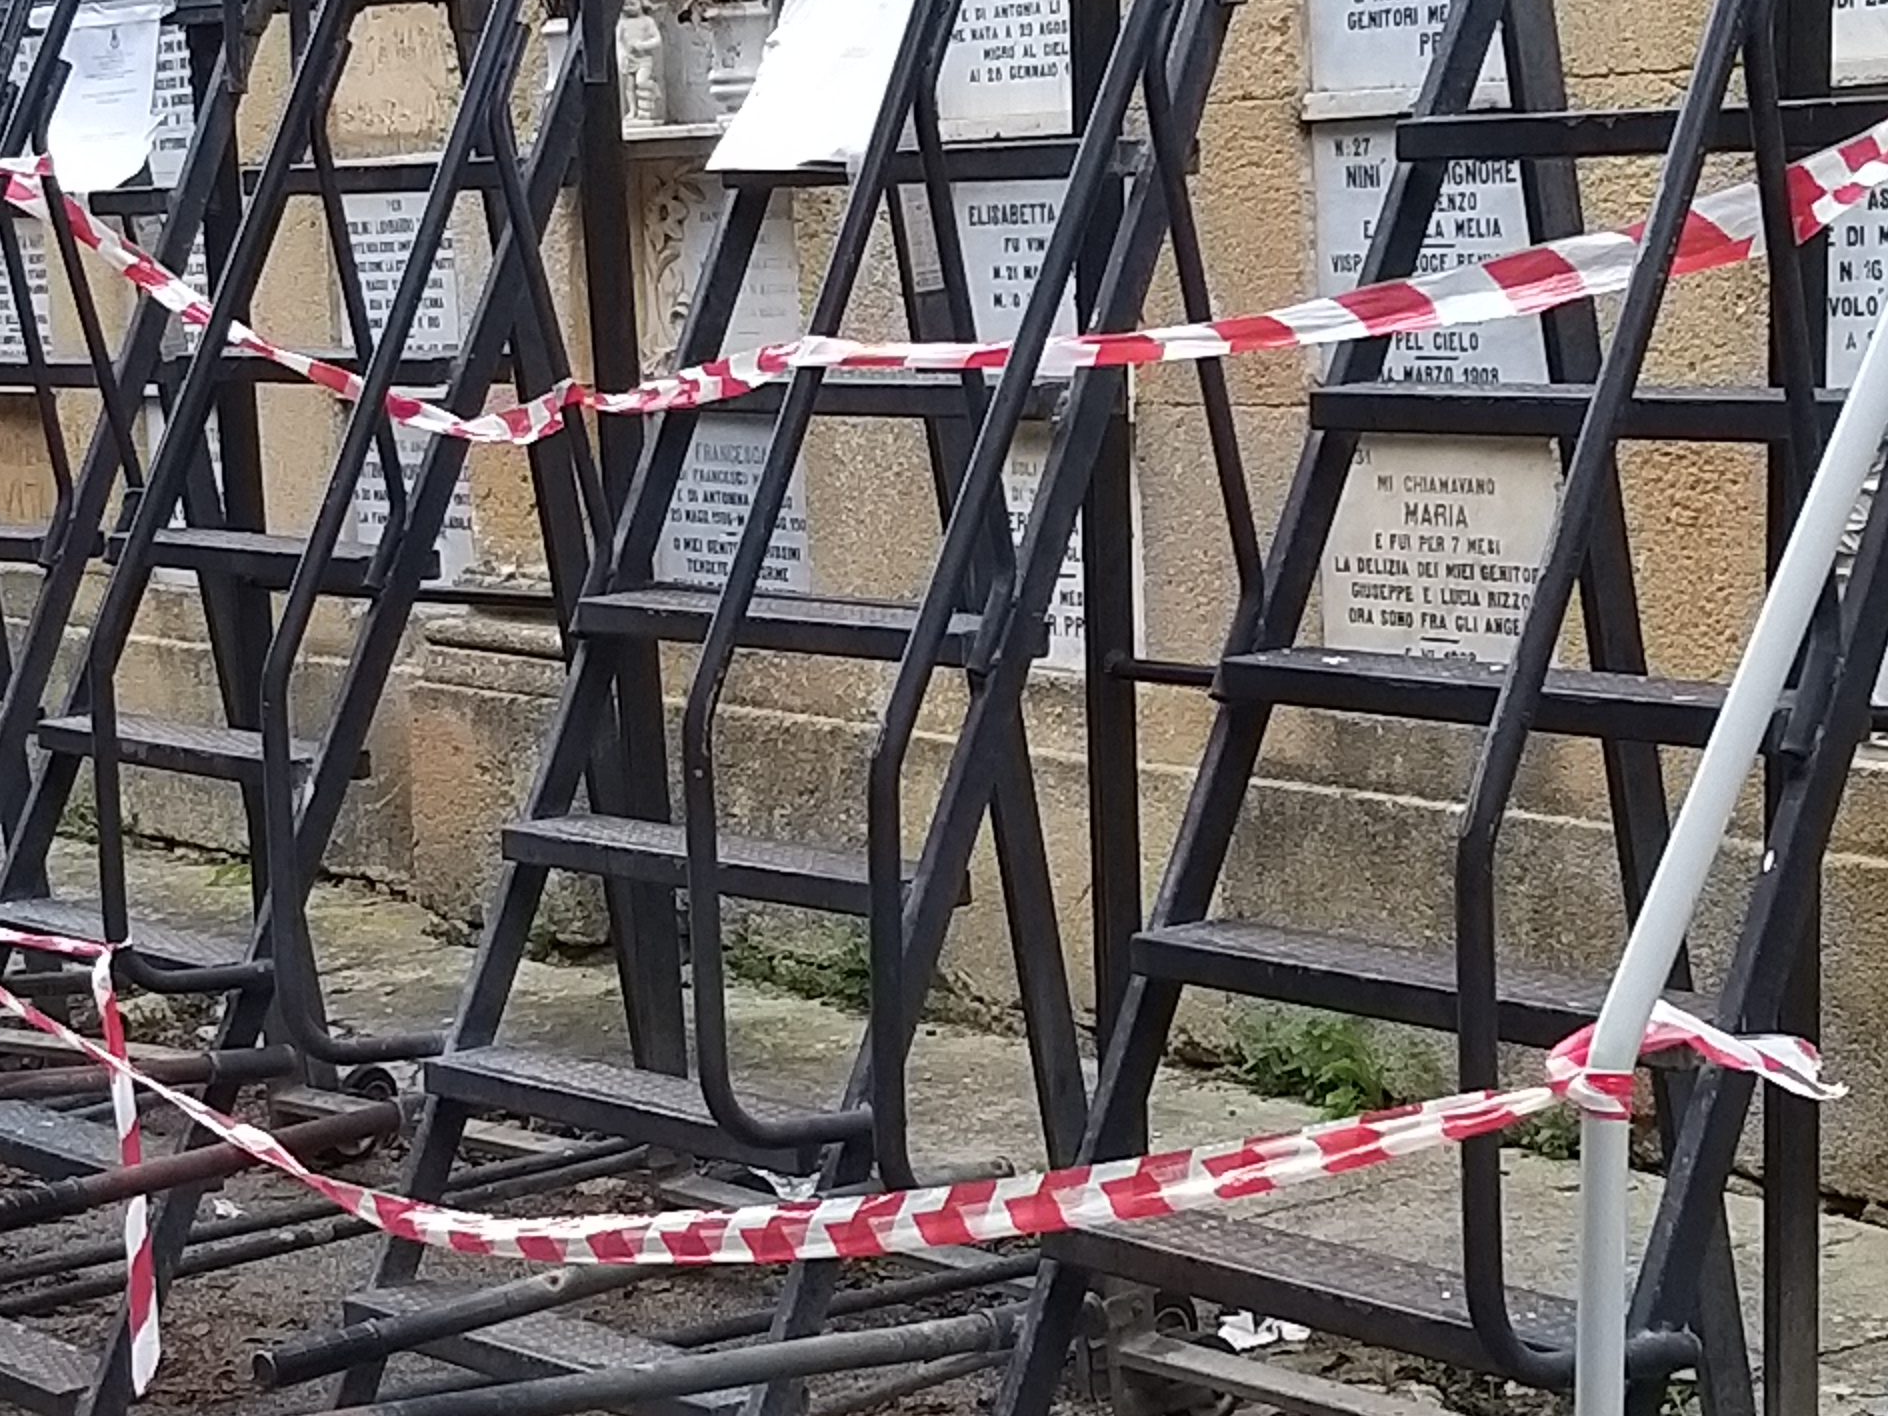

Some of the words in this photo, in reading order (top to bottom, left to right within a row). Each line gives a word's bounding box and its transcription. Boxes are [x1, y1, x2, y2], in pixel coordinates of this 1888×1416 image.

[1348, 7, 1418, 30] GENITORI
[968, 203, 1055, 226] ELISABETTA
[1847, 226, 1864, 247] DI
[1395, 332, 1424, 351] PEL
[1433, 330, 1478, 352] CIELO
[1378, 476, 1393, 492] MI
[1404, 475, 1494, 495] CHIAMAVANO
[1404, 503, 1468, 529] MARIA
[1390, 536, 1411, 551] FUI
[1419, 535, 1445, 553] PER
[1468, 539, 1500, 556] MESI
[1335, 556, 1350, 573] LA
[1358, 558, 1409, 577] DELIZIA
[1417, 562, 1438, 578] DEI
[1446, 563, 1474, 581] MIEI
[1352, 582, 1413, 603] GIUSEPPE
[1441, 589, 1480, 607] LUCIA
[1349, 607, 1373, 624] ORA
[1381, 611, 1413, 627] SONO
[1420, 613, 1447, 630] FRA
[1455, 615, 1478, 633] GLI
